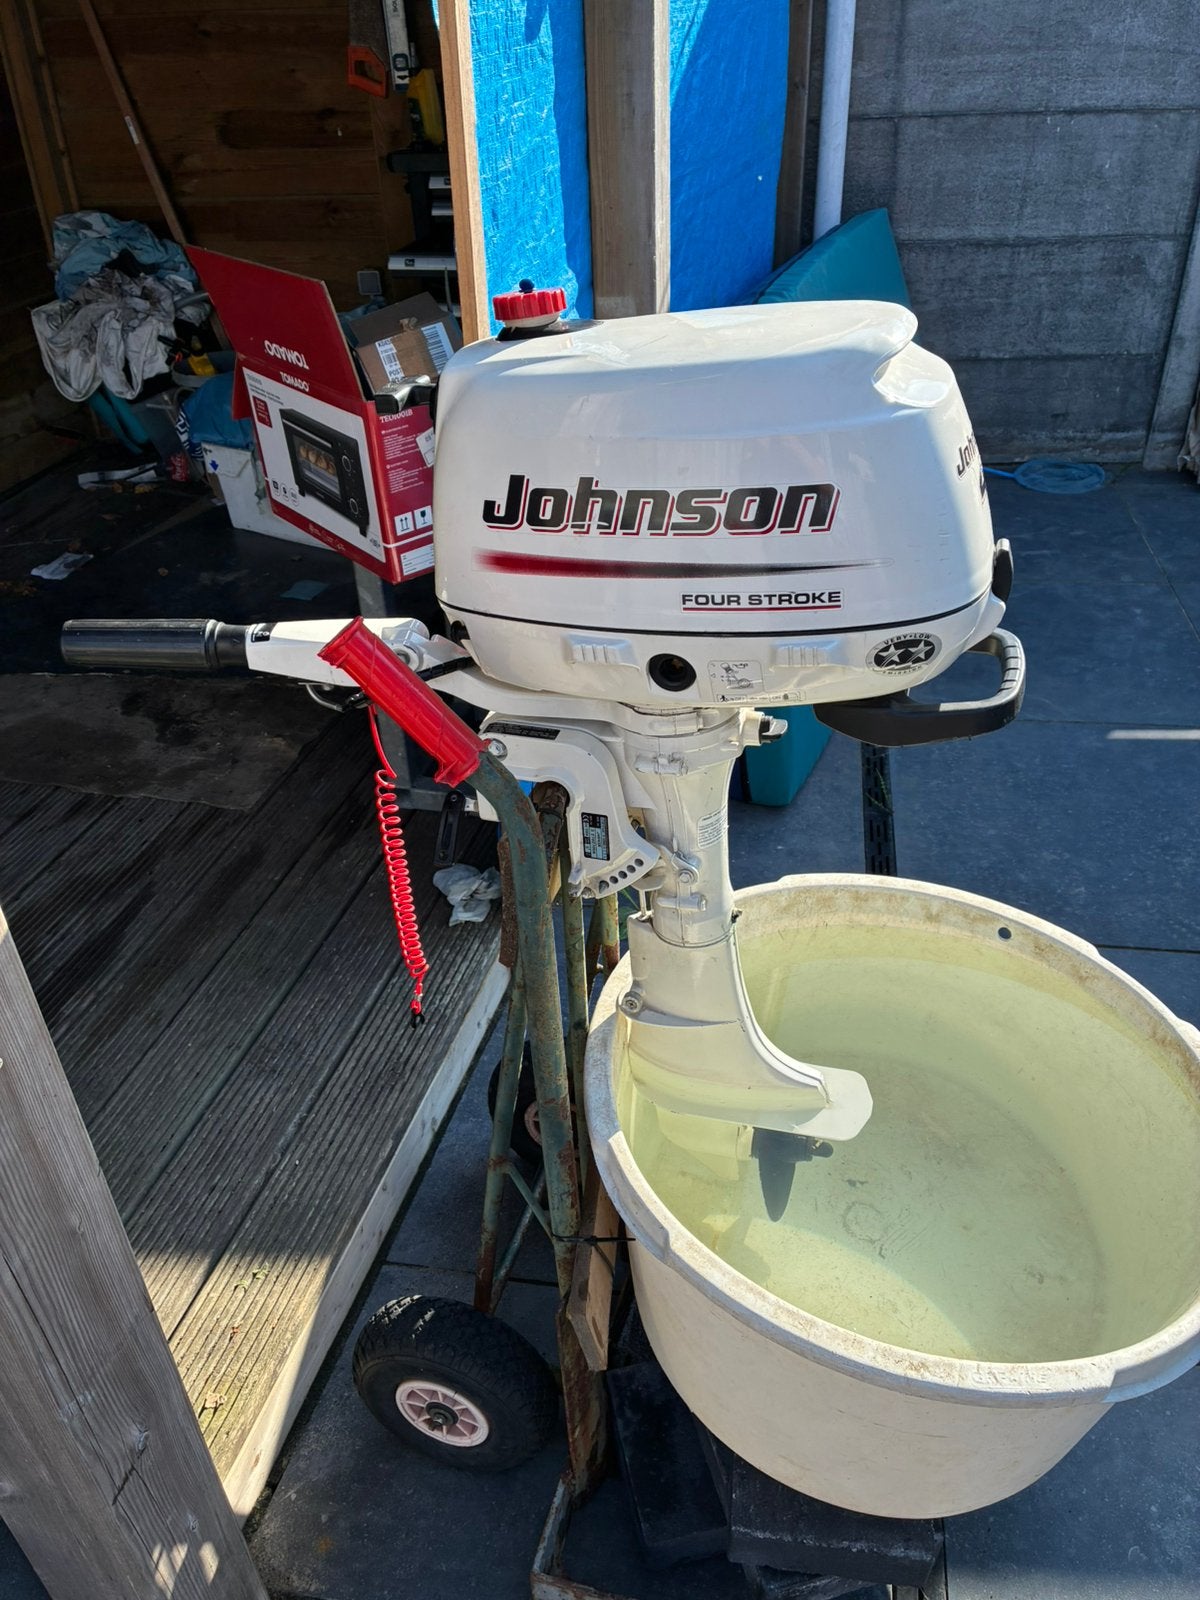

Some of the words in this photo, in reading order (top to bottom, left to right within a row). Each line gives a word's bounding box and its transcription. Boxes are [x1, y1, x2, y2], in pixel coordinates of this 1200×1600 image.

[264, 340, 310, 370] TOMADO
[280, 371, 309, 392] TOMADO
[482, 474, 841, 536] Johnson
[681, 592, 742, 607] FOUR
[747, 590, 842, 606] STROKE
